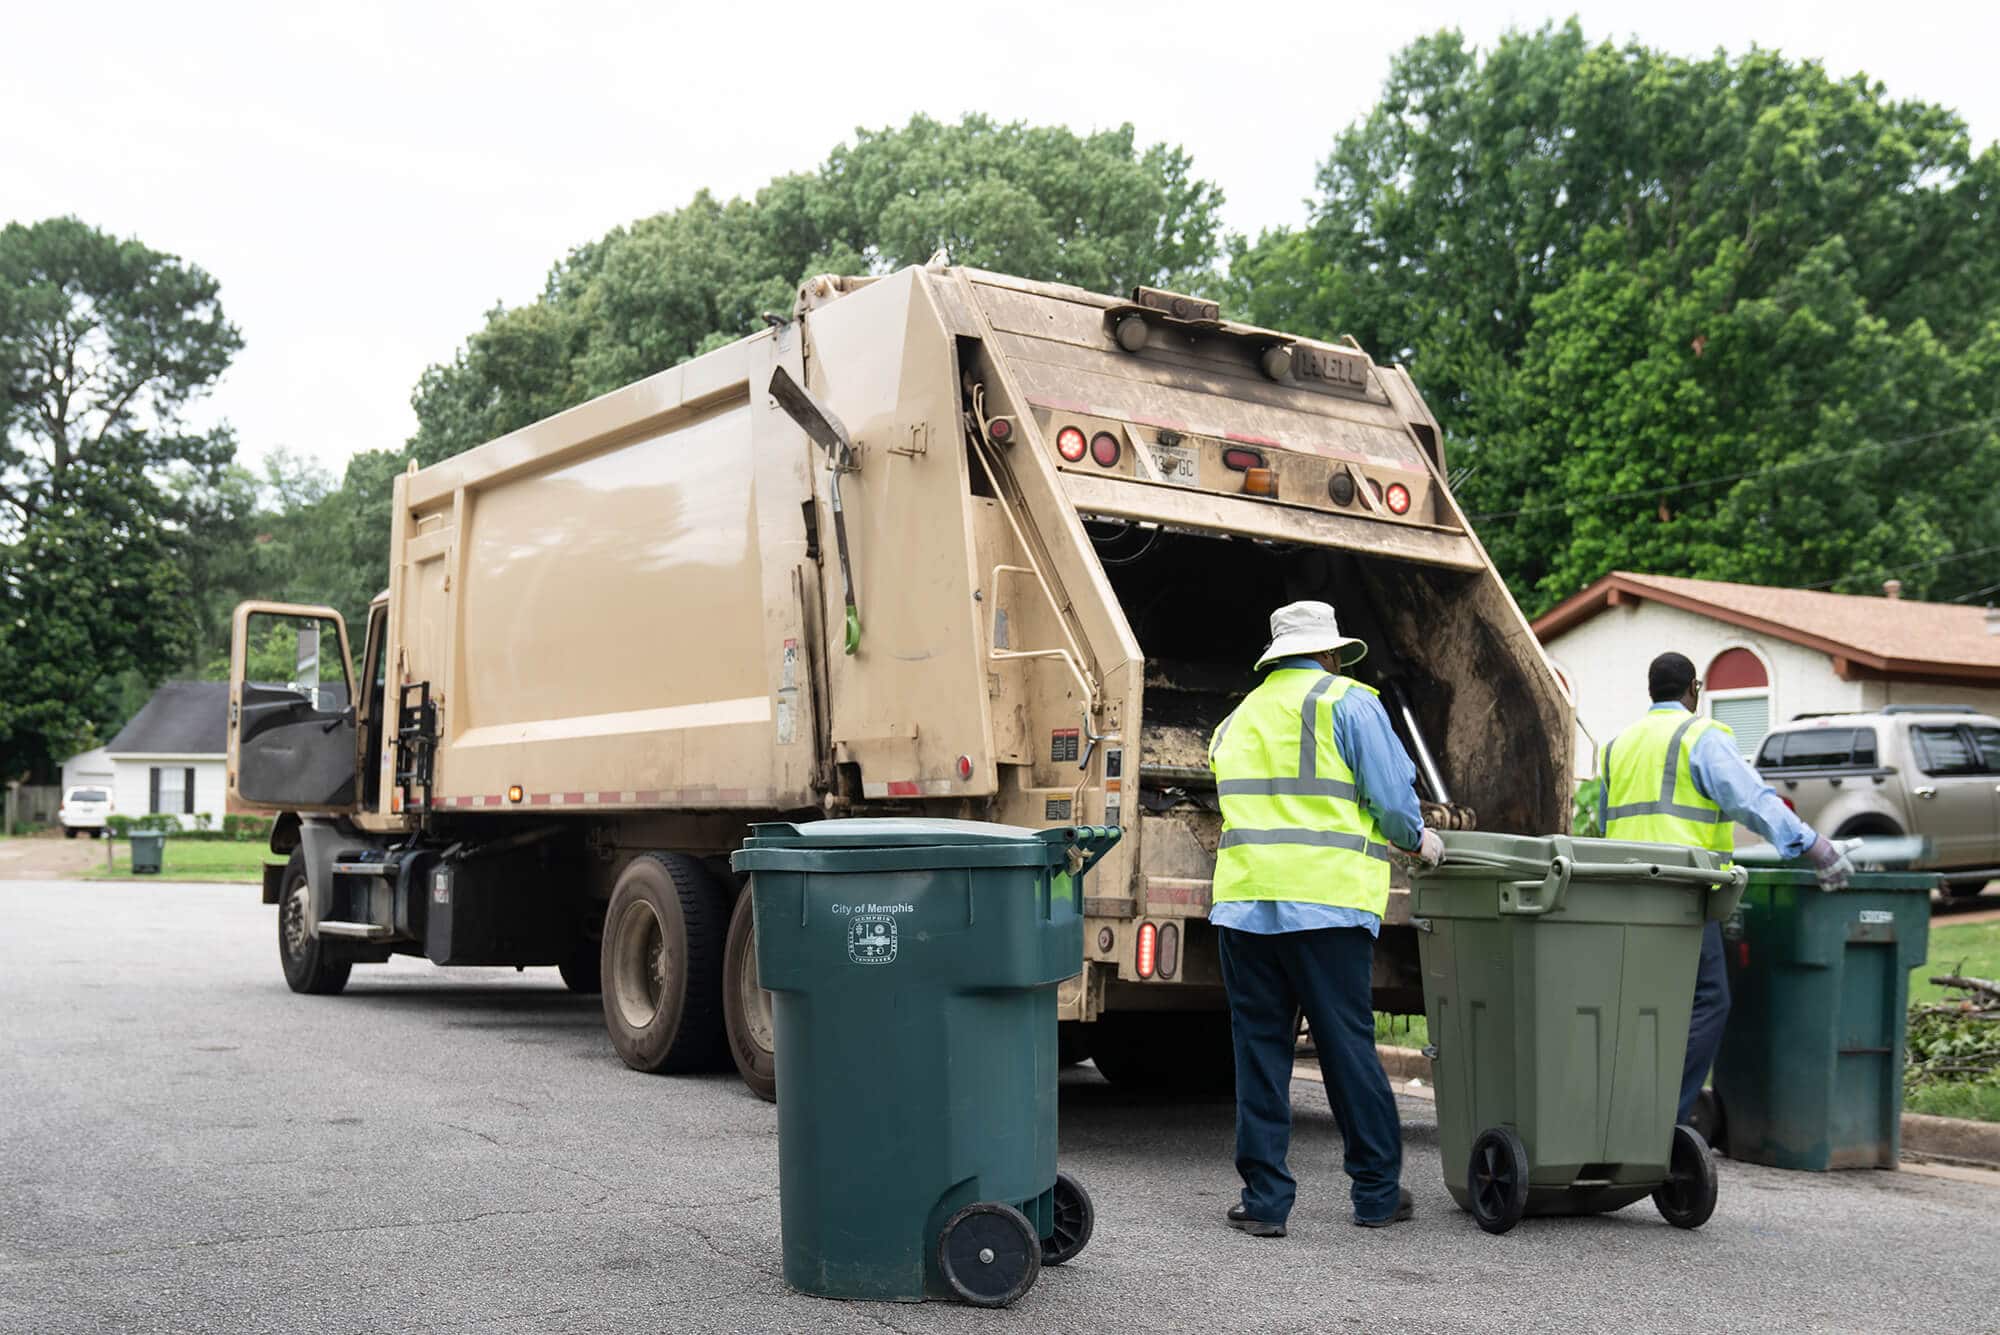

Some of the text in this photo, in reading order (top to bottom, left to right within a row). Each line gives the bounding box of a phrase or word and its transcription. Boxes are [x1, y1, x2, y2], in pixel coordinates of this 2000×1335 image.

[831, 903, 914, 915] City of Memphis
